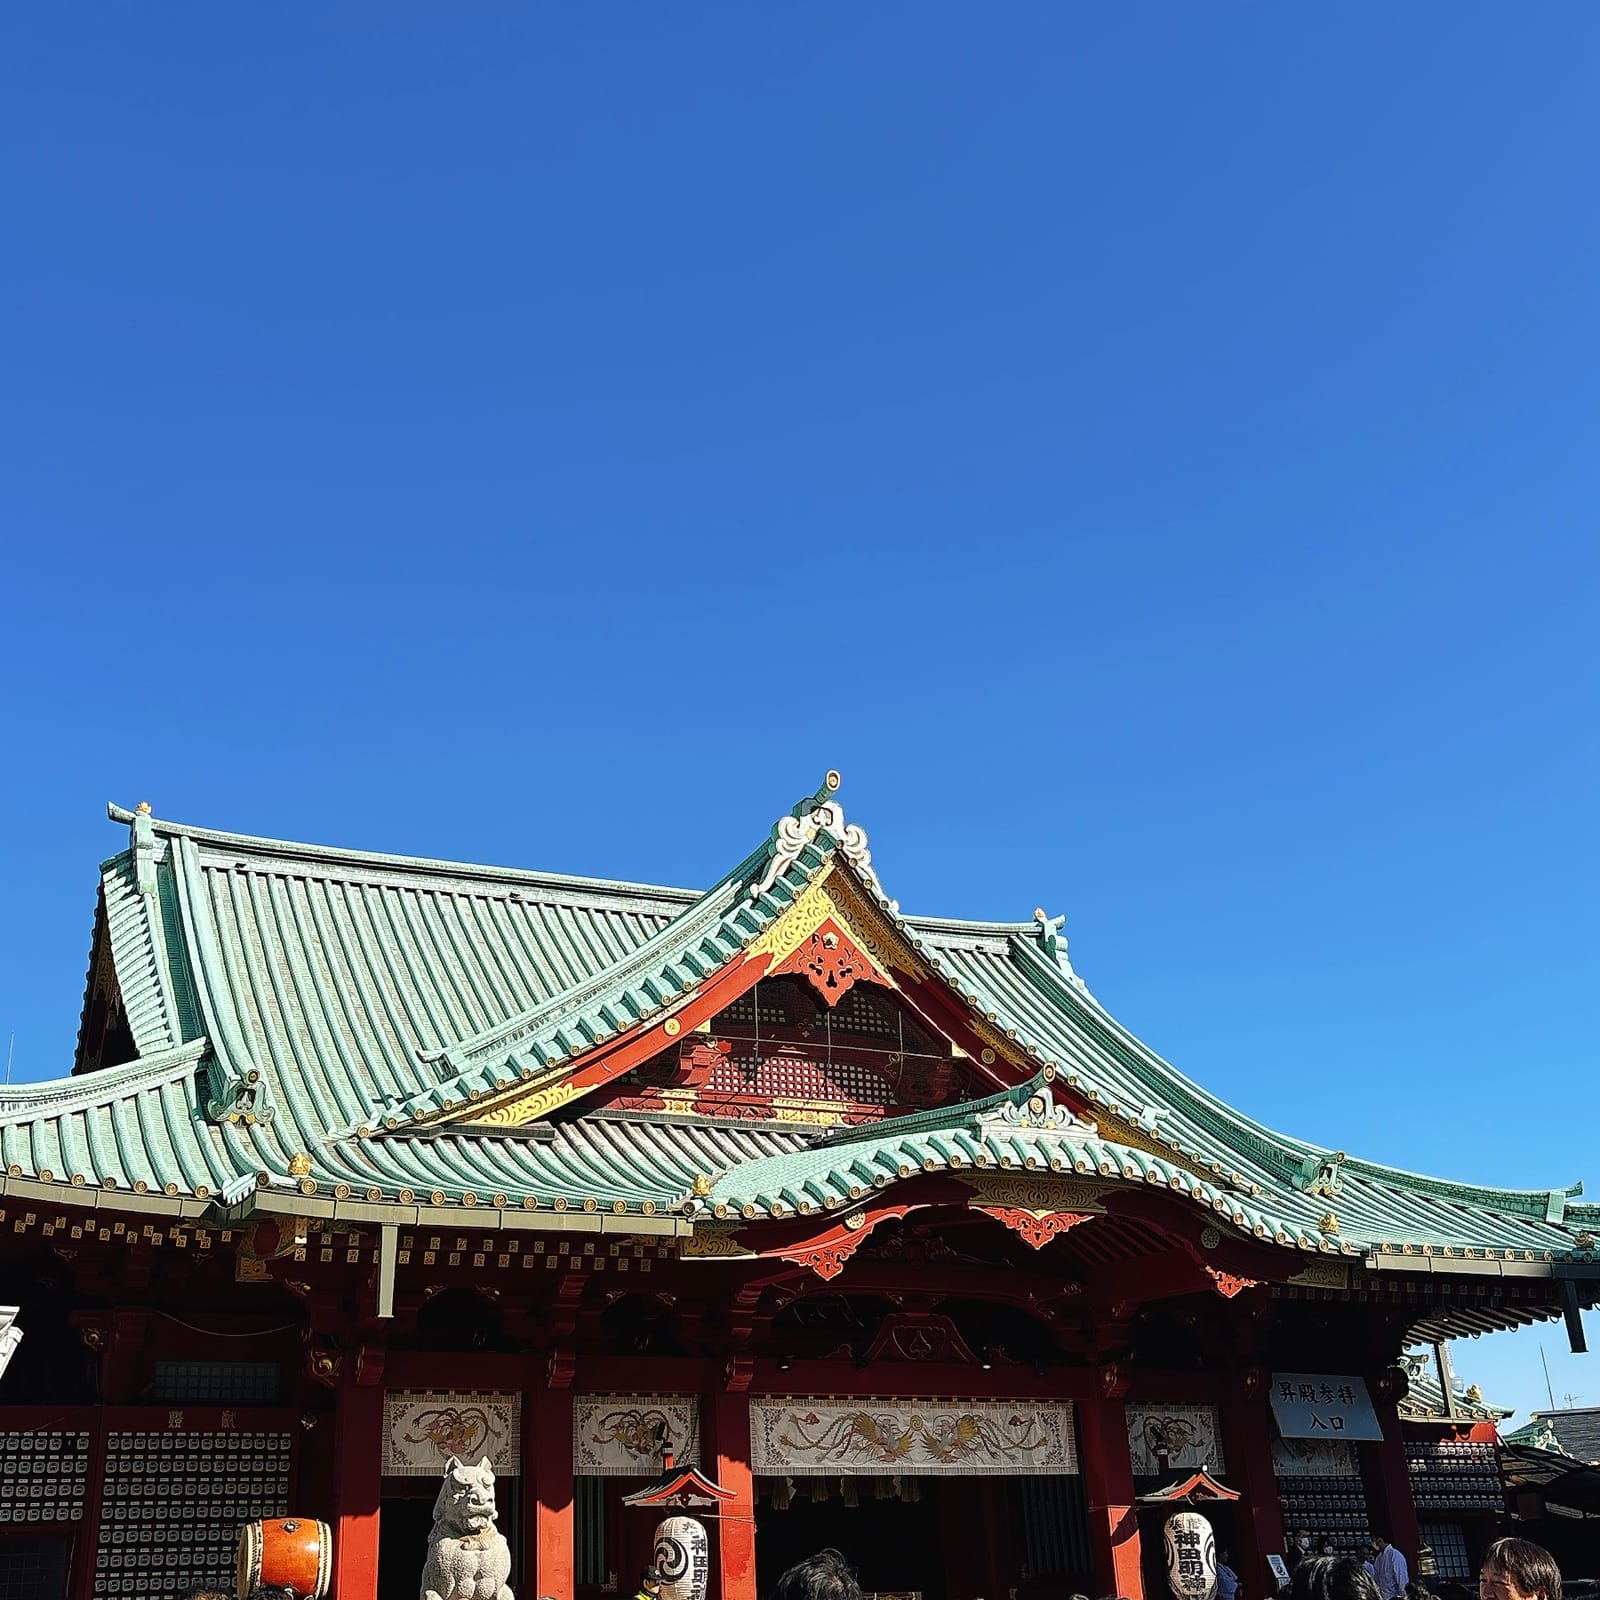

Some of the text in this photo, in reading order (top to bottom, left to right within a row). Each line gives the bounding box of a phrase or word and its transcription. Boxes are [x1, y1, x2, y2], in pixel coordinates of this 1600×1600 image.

[1279, 1381, 1357, 1405] 昇殿参拝
[1310, 1412, 1345, 1431] 入口
[1174, 1530, 1206, 1592] 神田明神
